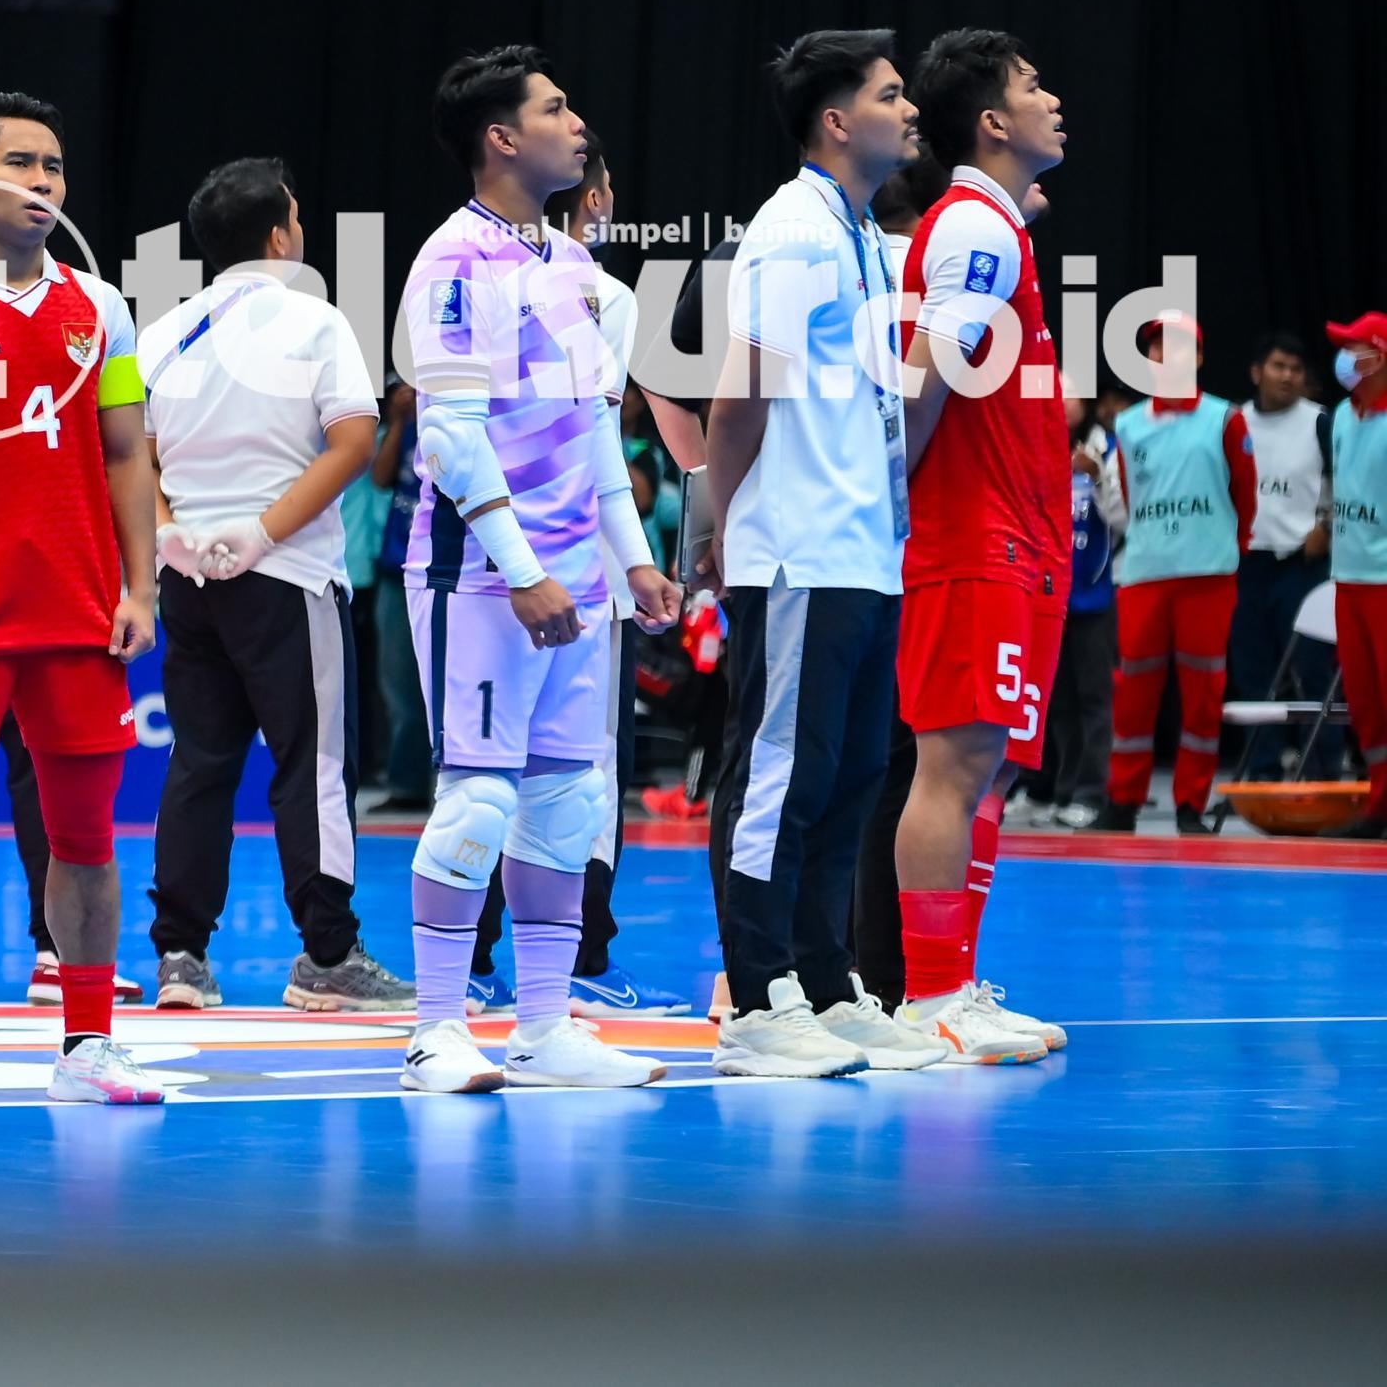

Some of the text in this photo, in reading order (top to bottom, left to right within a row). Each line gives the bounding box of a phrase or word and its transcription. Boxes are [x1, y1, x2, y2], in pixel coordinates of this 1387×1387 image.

[21, 384, 61, 449] 4
[1135, 495, 1214, 522] MEDICAL
[996, 641, 1022, 702] 5
[476, 680, 495, 741] 1
